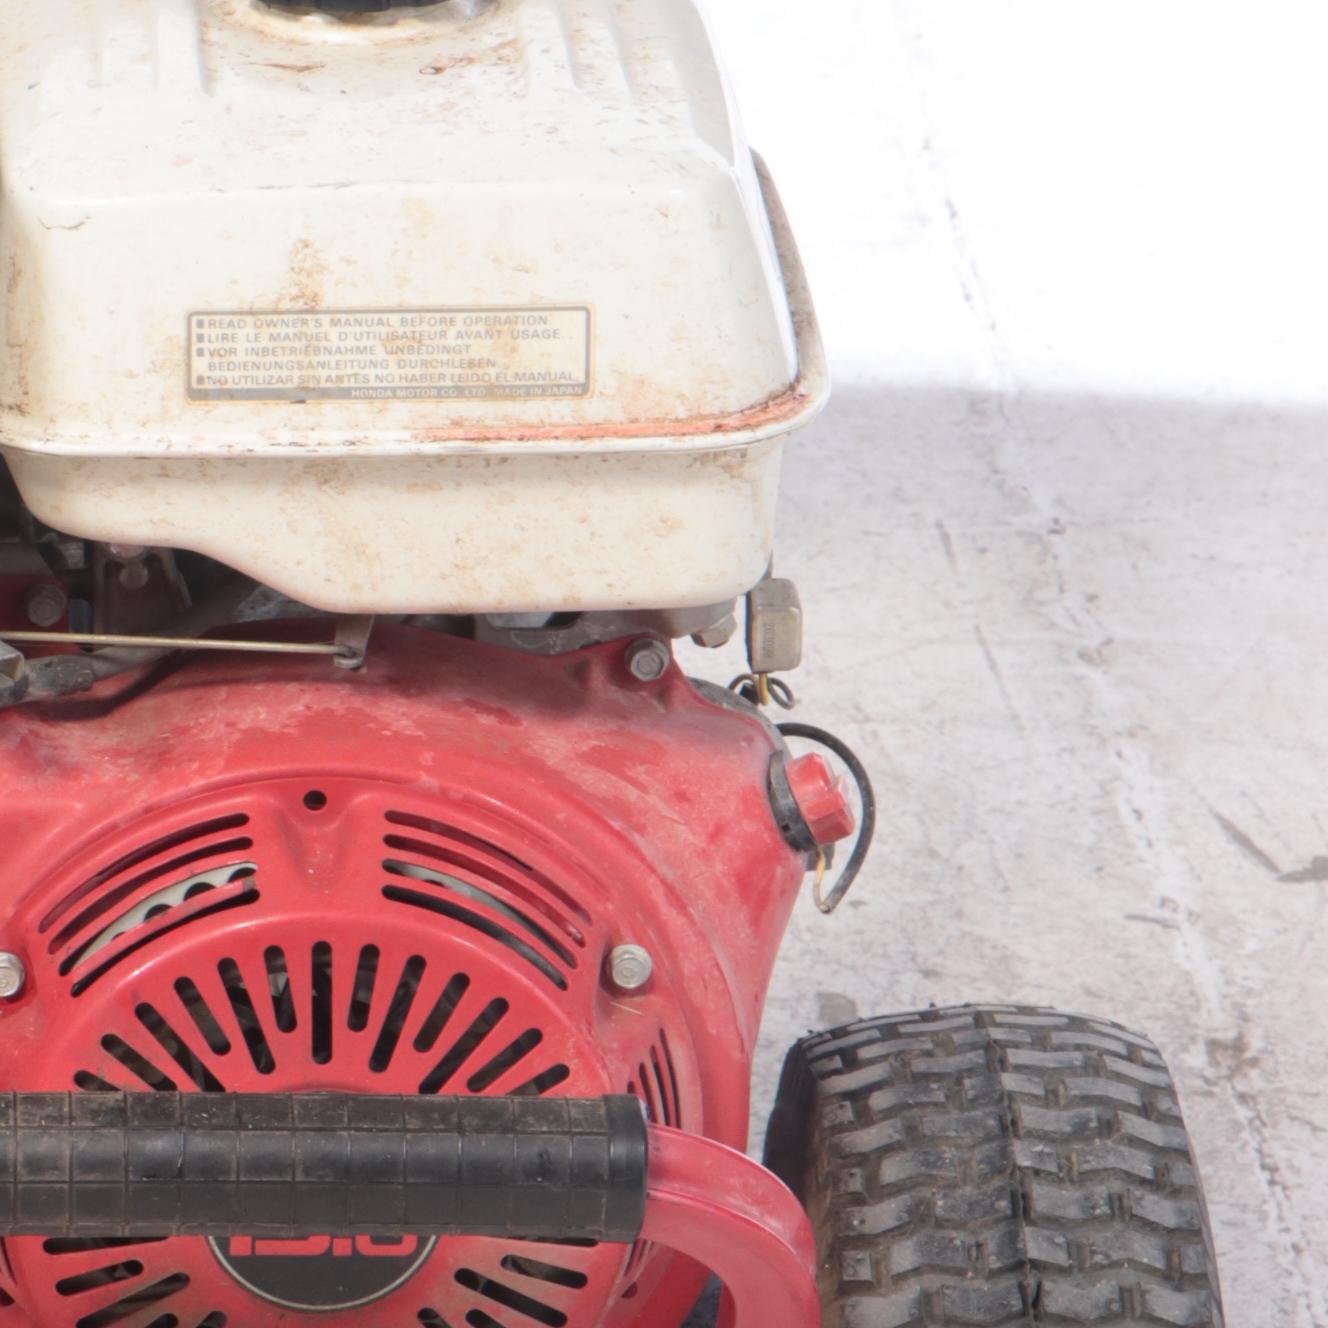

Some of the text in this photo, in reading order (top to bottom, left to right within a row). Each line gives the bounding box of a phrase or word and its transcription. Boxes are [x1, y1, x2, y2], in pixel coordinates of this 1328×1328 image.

[207, 318, 247, 329] READ
[253, 318, 323, 329] OWNER'S
[329, 317, 394, 328] MANUAL
[399, 316, 457, 327] BEFORE
[207, 333, 239, 344] LIRE
[245, 332, 263, 343] LE
[268, 331, 332, 343] MANUEL
[338, 329, 449, 342] D'UTILISATEUR
[455, 329, 503, 340] AVANT
[207, 343, 472, 358] VOR INBETRIEBNAHME UNBEDINGT
[207, 359, 390, 372] BEDIENUNGSANLEITUNG
[206, 375, 228, 385] NO
[231, 374, 294, 385] UTILIZAR
[297, 374, 321, 385] SIN
[324, 374, 370, 385] ANTES
[374, 373, 395, 384] NO
[398, 372, 447, 384] HABER
[449, 372, 492, 383] LEIDO
[495, 372, 510, 382] EL
[351, 388, 393, 398] HONDA
[396, 387, 438, 397] MOTOR
[494, 386, 527, 396] MADE
[530, 386, 542, 395] IN
[545, 386, 582, 395] JAPAN
